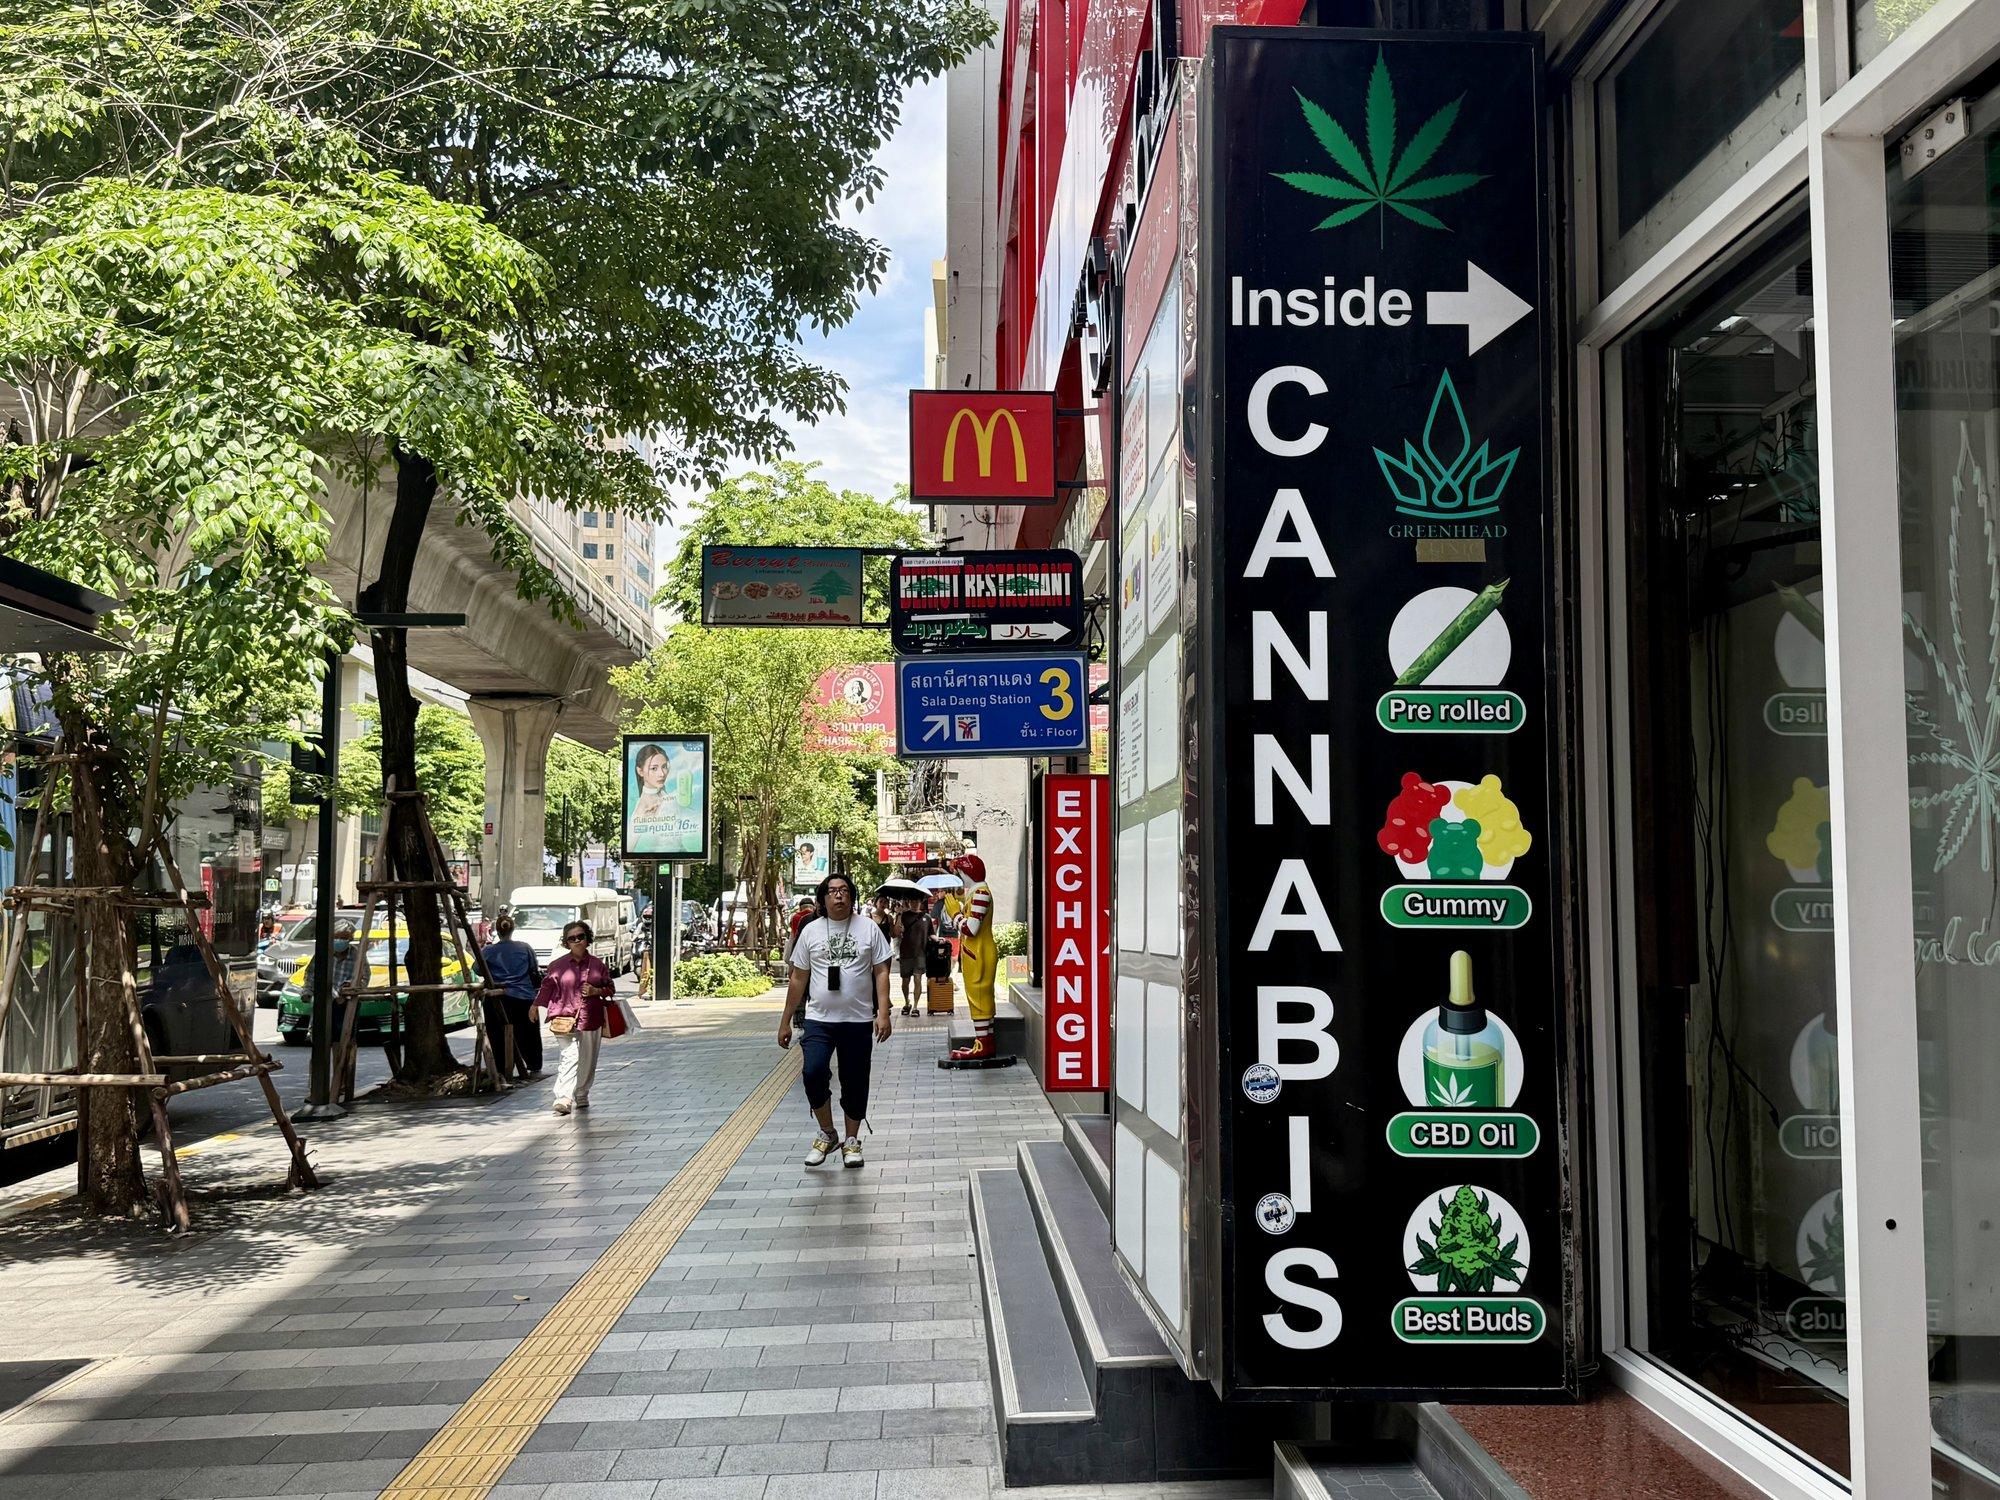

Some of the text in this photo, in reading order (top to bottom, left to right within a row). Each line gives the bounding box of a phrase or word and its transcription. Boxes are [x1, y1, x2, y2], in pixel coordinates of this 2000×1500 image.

[1232, 276, 1413, 328] Inside
[1388, 524, 1508, 539] GREENHEAD
[710, 549, 800, 569] Beirut
[911, 668, 1032, 689] สถานีศาลาแดง
[921, 694, 1032, 709] Sala Daeng Station
[1038, 667, 1075, 721] 3
[1390, 699, 1511, 721] Pre rolled
[1046, 727, 1078, 738] Floor
[1243, 365, 1344, 1351] CANNABIS
[1403, 894, 1507, 922] Gummy
[1054, 790, 1086, 1081] EXCHANGE
[1410, 1123, 1515, 1147] CBD Oil
[1404, 1306, 1532, 1332] Best Buds
